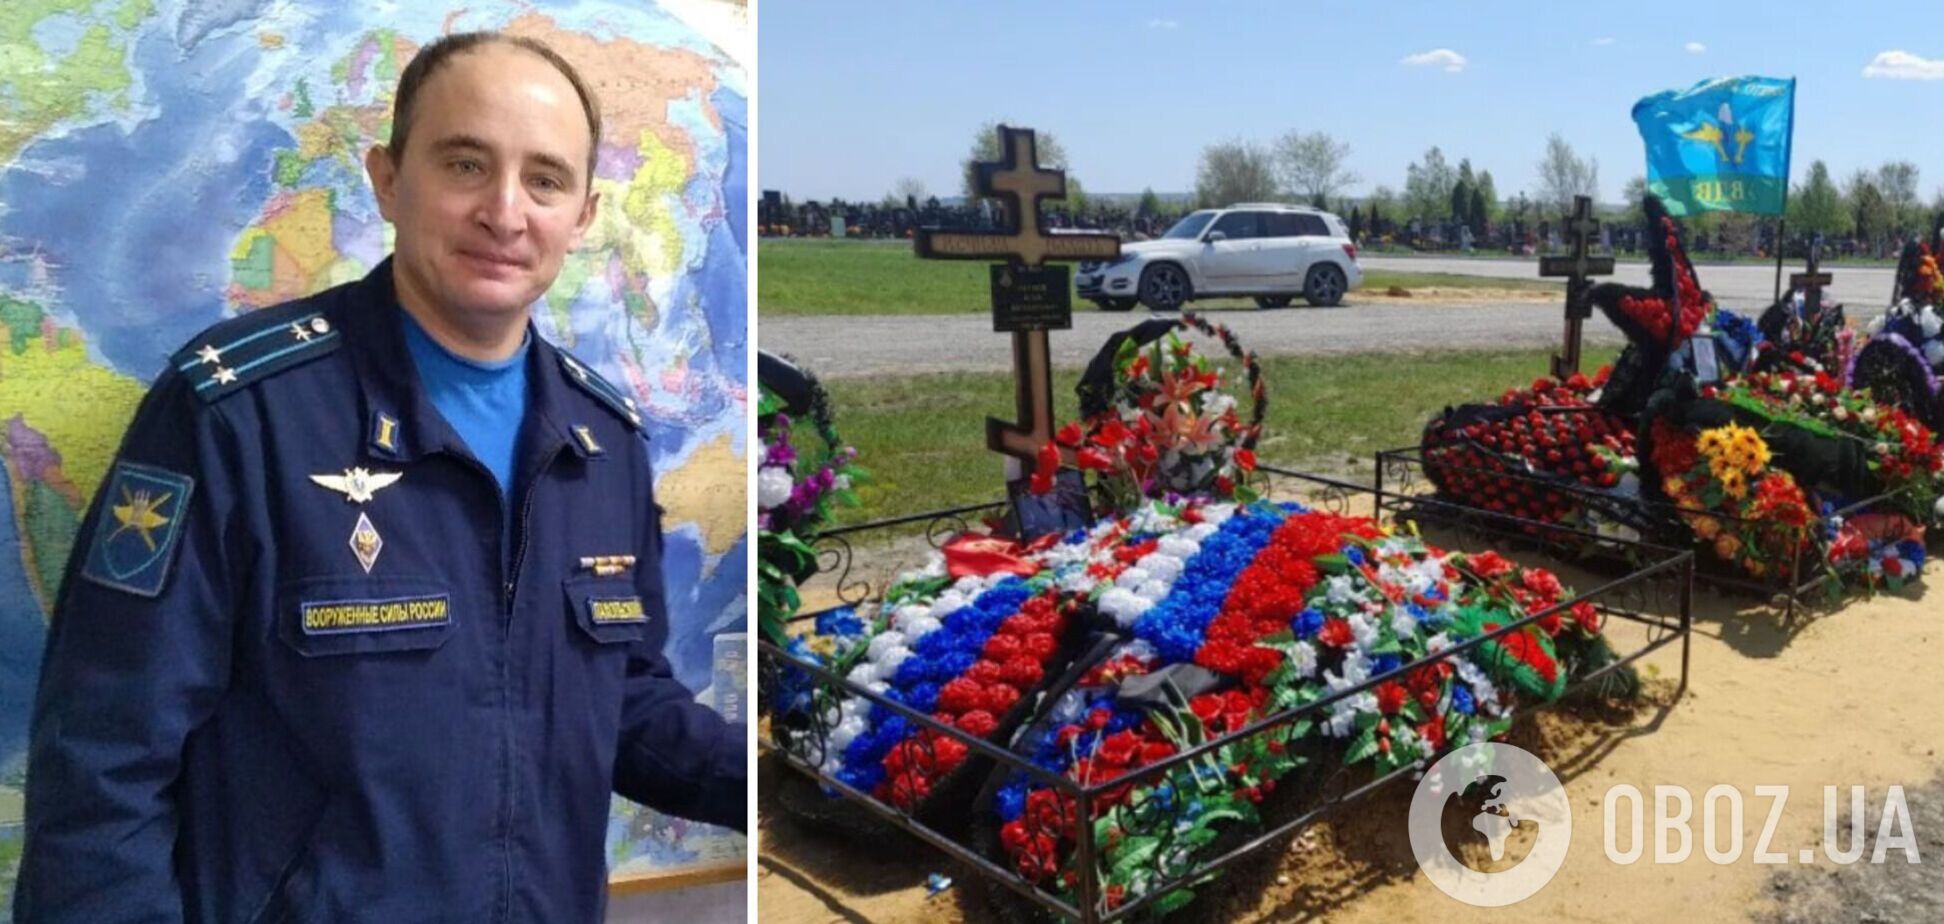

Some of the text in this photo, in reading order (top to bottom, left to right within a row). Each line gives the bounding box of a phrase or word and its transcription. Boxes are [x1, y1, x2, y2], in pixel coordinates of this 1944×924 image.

[306, 600, 446, 627] ВООРУЖЕННЫЕ СИЛЫ РОССИИ
